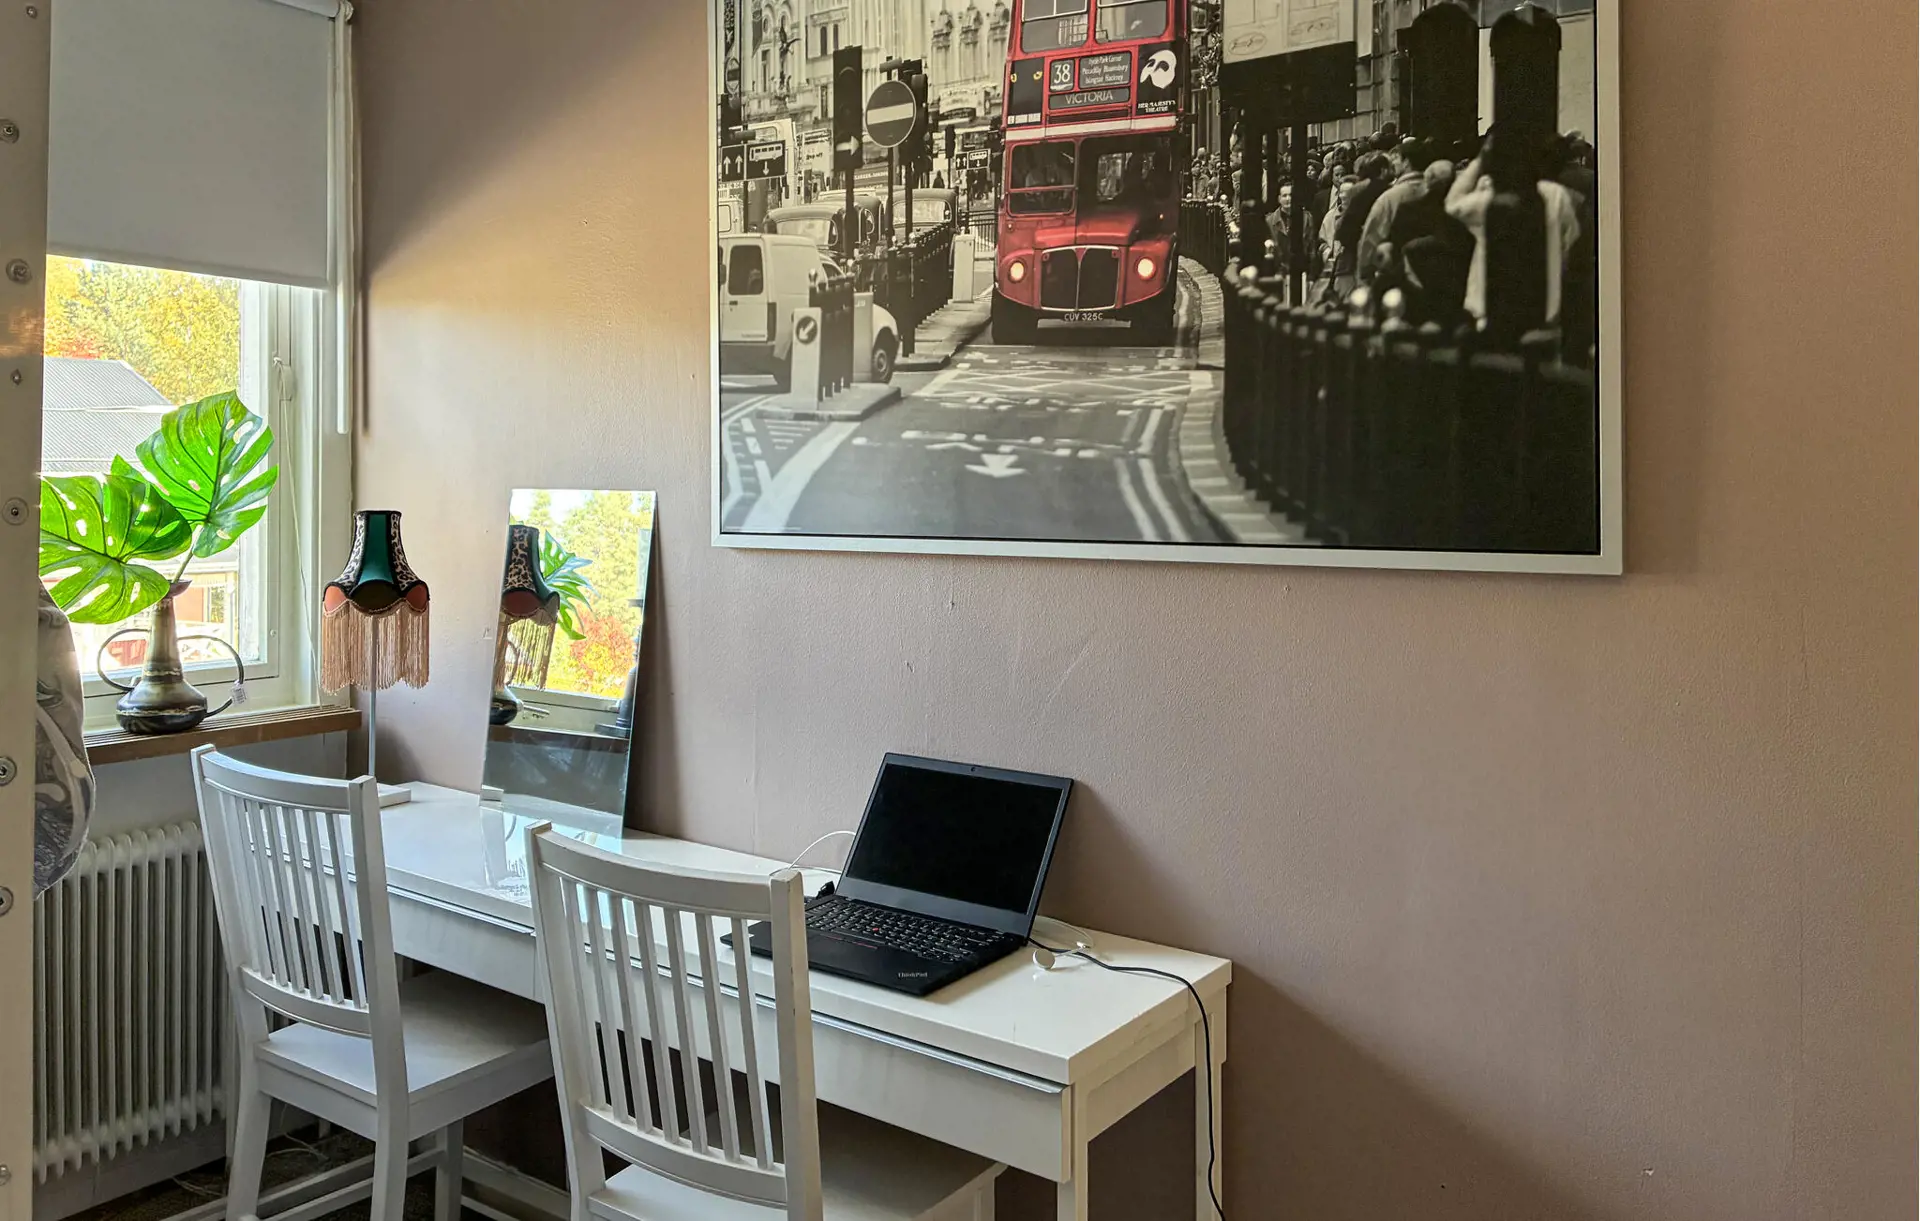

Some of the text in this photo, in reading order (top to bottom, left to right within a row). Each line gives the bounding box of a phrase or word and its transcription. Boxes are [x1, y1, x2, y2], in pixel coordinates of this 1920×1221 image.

[1053, 63, 1071, 84] 38
[1065, 90, 1114, 105] VICTORIA
[1064, 312, 1104, 321] CUV 325C
